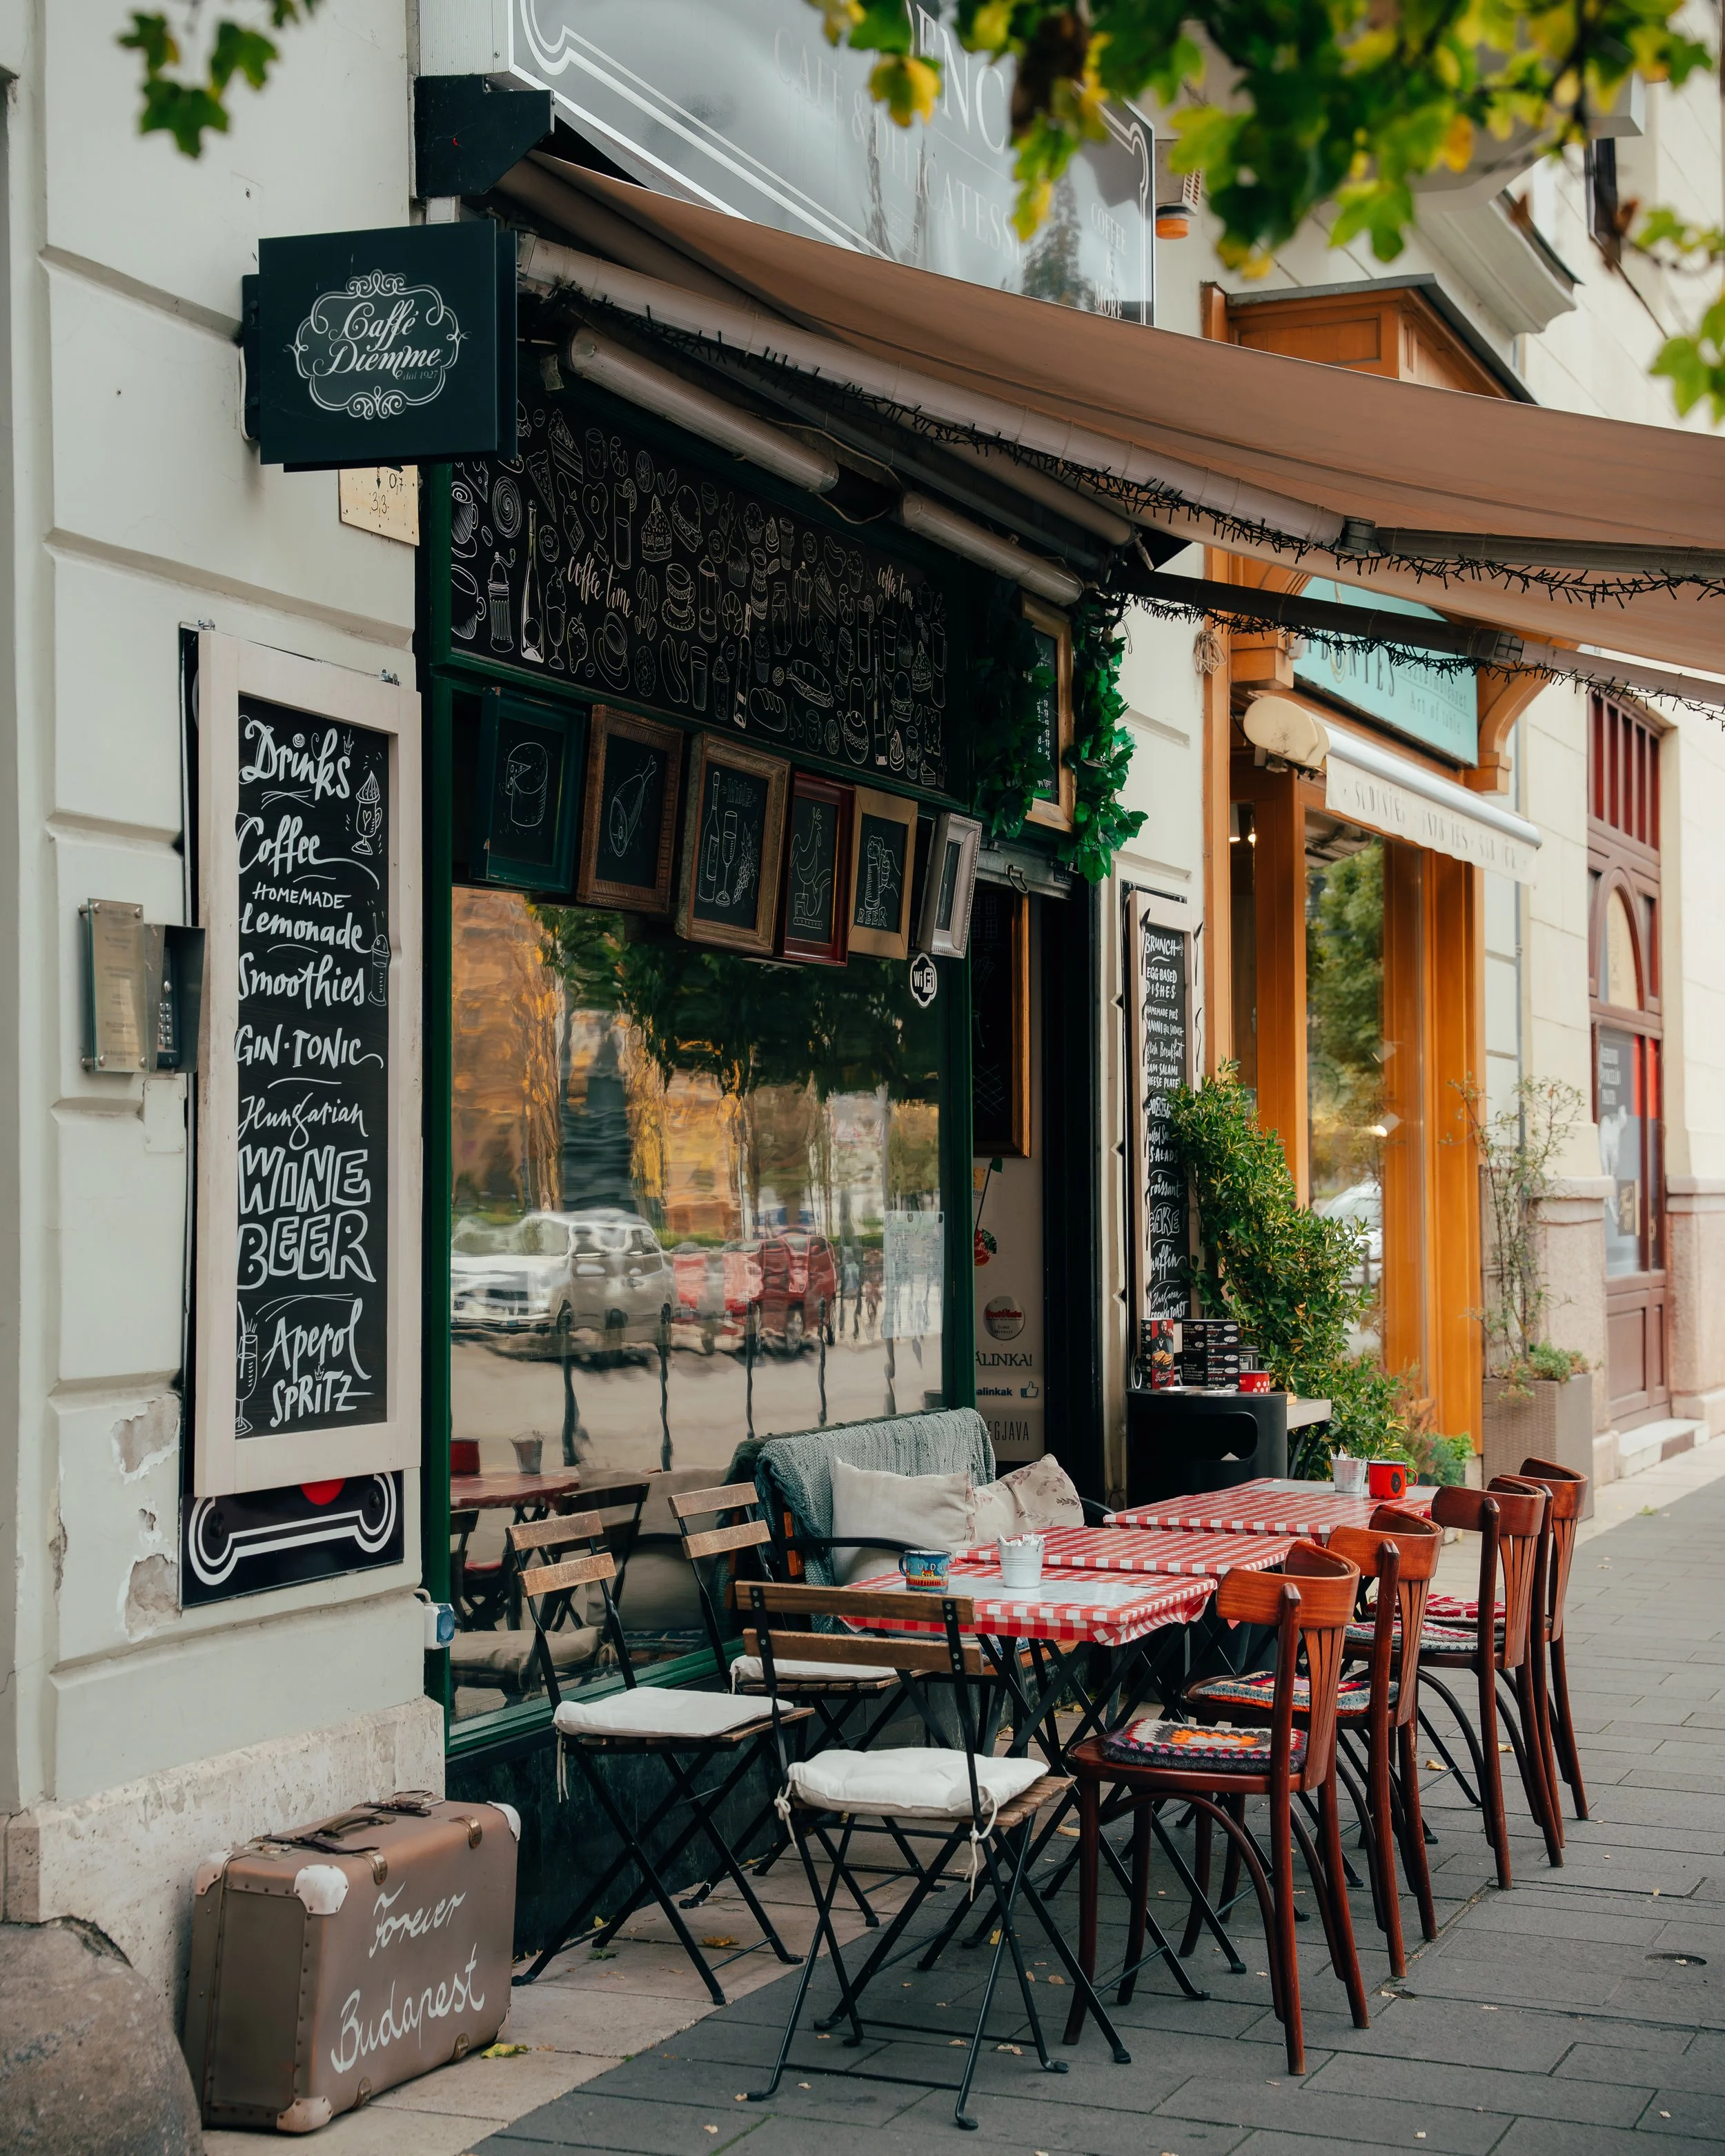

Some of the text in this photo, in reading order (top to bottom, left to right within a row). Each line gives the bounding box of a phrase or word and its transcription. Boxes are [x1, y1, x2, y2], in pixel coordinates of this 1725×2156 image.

[873, 106, 1021, 264] DELICATESS
[1091, 202, 1126, 256] COFFEE
[313, 339, 442, 379] Diemme
[420, 370, 438, 379] 1927
[568, 552, 633, 617] coffee time
[878, 564, 915, 610] coffee time
[239, 715, 351, 800] Drinks
[238, 813, 362, 884] Coffee
[252, 882, 352, 909] HOMEMADE
[857, 907, 887, 927] BEER
[239, 902, 371, 953] Lemonade
[1145, 932, 1176, 957] BRUNCH
[238, 952, 364, 1009] Smoothies
[1145, 1005, 1179, 1020] HOMEMADE PIES
[1147, 1019, 1163, 1034] ANINI
[1146, 1038, 1185, 1065] glish Breakfast
[1147, 1076, 1163, 1089] HEESE
[238, 1093, 368, 1150] Hungarian
[239, 1145, 371, 1214] WINE
[1150, 1174, 1182, 1198] roissant
[237, 1209, 376, 1289] BEER
[1170, 1301, 1189, 1319] TOAST
[262, 1298, 371, 1384] Aperol
[974, 1351, 1033, 1367] ÁLINKA!
[270, 1369, 373, 1427] SPRITZ
[975, 1387, 1013, 1397] alinkak
[368, 1881, 466, 1959] Forever
[331, 1943, 485, 2074] Budapest
